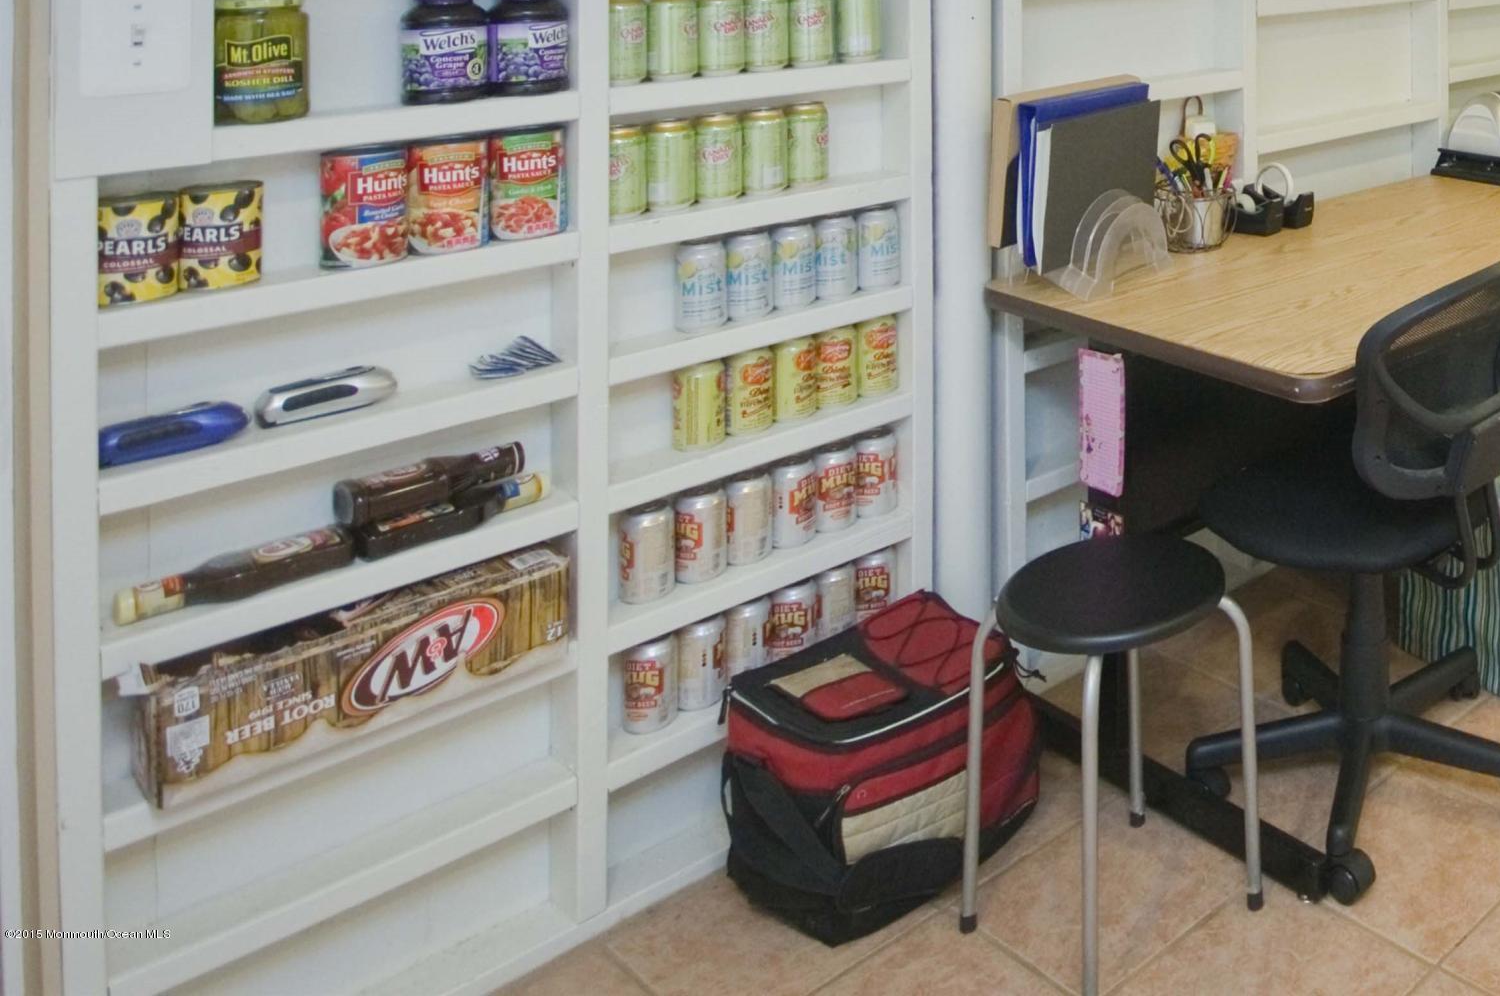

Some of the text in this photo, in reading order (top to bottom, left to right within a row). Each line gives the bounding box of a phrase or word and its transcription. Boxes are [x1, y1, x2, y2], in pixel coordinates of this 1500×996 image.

[423, 31, 478, 52] Welch's
[230, 42, 288, 64] Mt. Olive
[430, 53, 470, 64] Concord
[434, 60, 466, 71] Grape
[224, 75, 294, 88] KOSHER DILL
[503, 151, 557, 173] Hunt's
[356, 170, 408, 195] Hunt's
[423, 163, 480, 185] Hunt's
[182, 246, 227, 254] COLOSSAL
[103, 257, 154, 269] COLOSSAL
[681, 276, 723, 297] Mist
[546, 625, 563, 642] 12
[376, 607, 473, 703] A&W
[177, 702, 197, 715] 170
[248, 690, 313, 721] SINCE 1919
[225, 693, 336, 745] ROOT BEER
